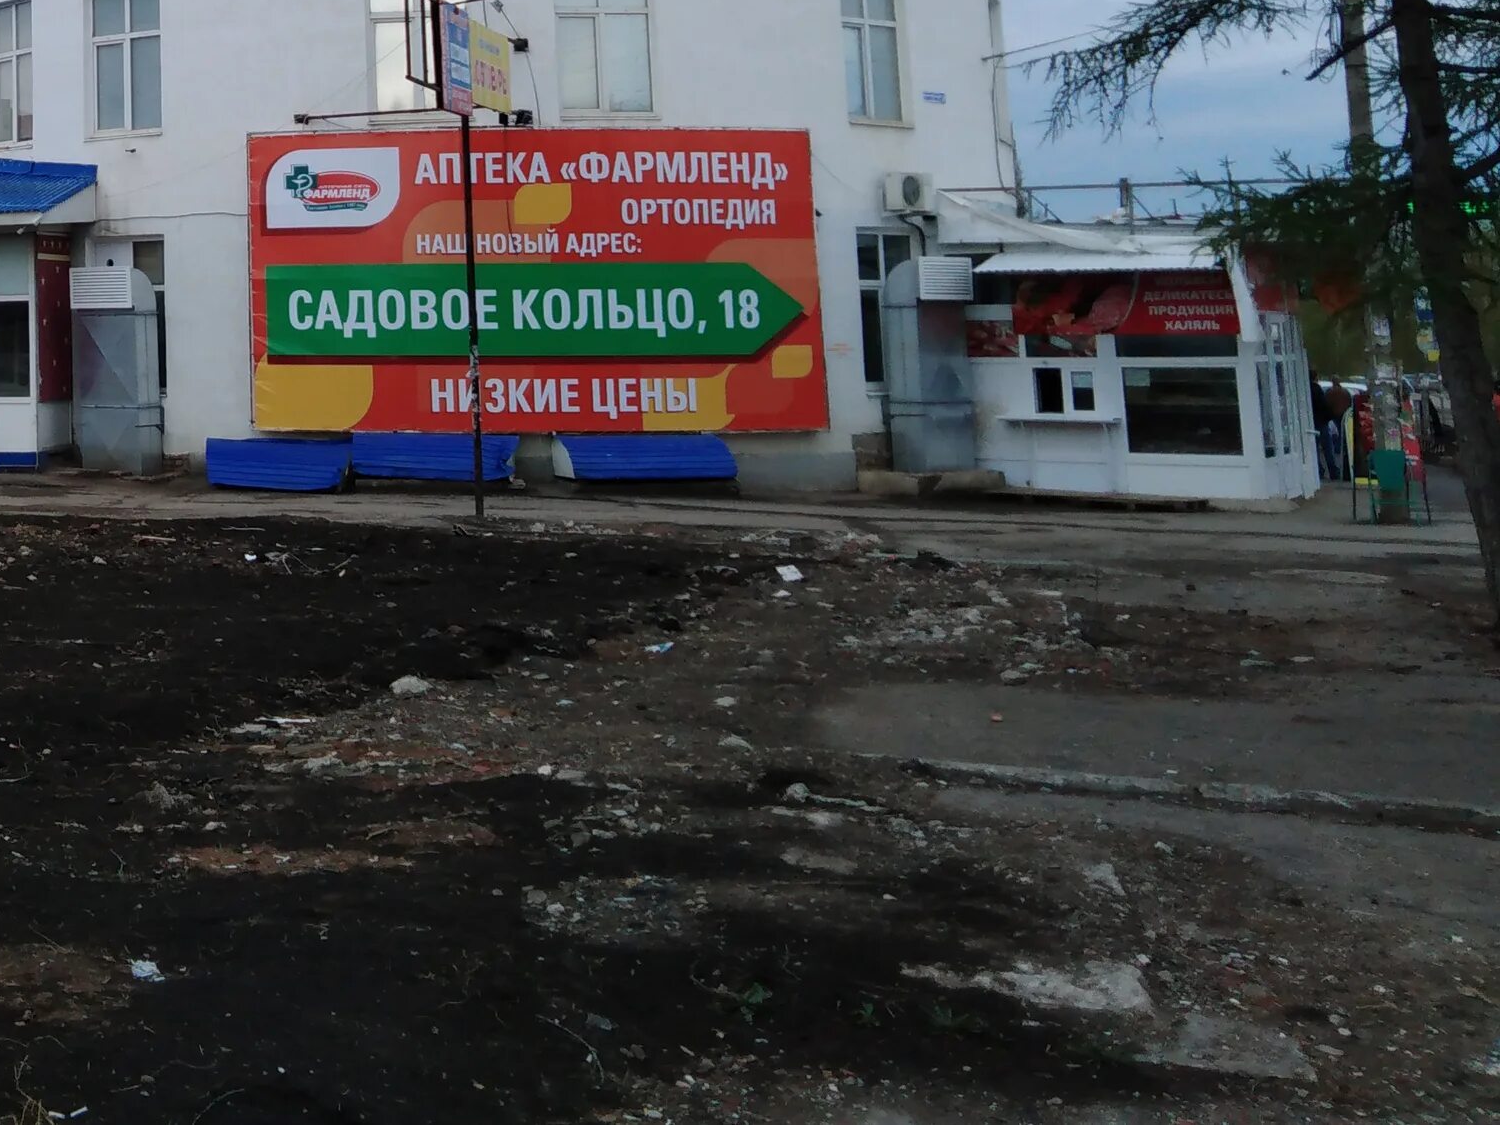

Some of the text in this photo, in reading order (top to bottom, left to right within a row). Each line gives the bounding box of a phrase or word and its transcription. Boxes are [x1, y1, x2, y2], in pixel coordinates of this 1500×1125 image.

[415, 151, 789, 189] АПТЕКА «ФАРМЛЕНД»
[303, 188, 370, 199] ФАРМЛЕНД
[621, 198, 777, 229] ОРТОПЕДИЯ
[416, 228, 643, 258] НАШ НОВЫЙ АДРЕС:
[288, 288, 760, 339] САДОВОЕ КОЛЬЦО, 18
[1148, 305, 1234, 317] ПРОДУКЦИЯ
[1164, 320, 1221, 331] ХАЛЯЛЬ
[430, 378, 697, 419] НИЗКИЕ ЦЕНЫ
